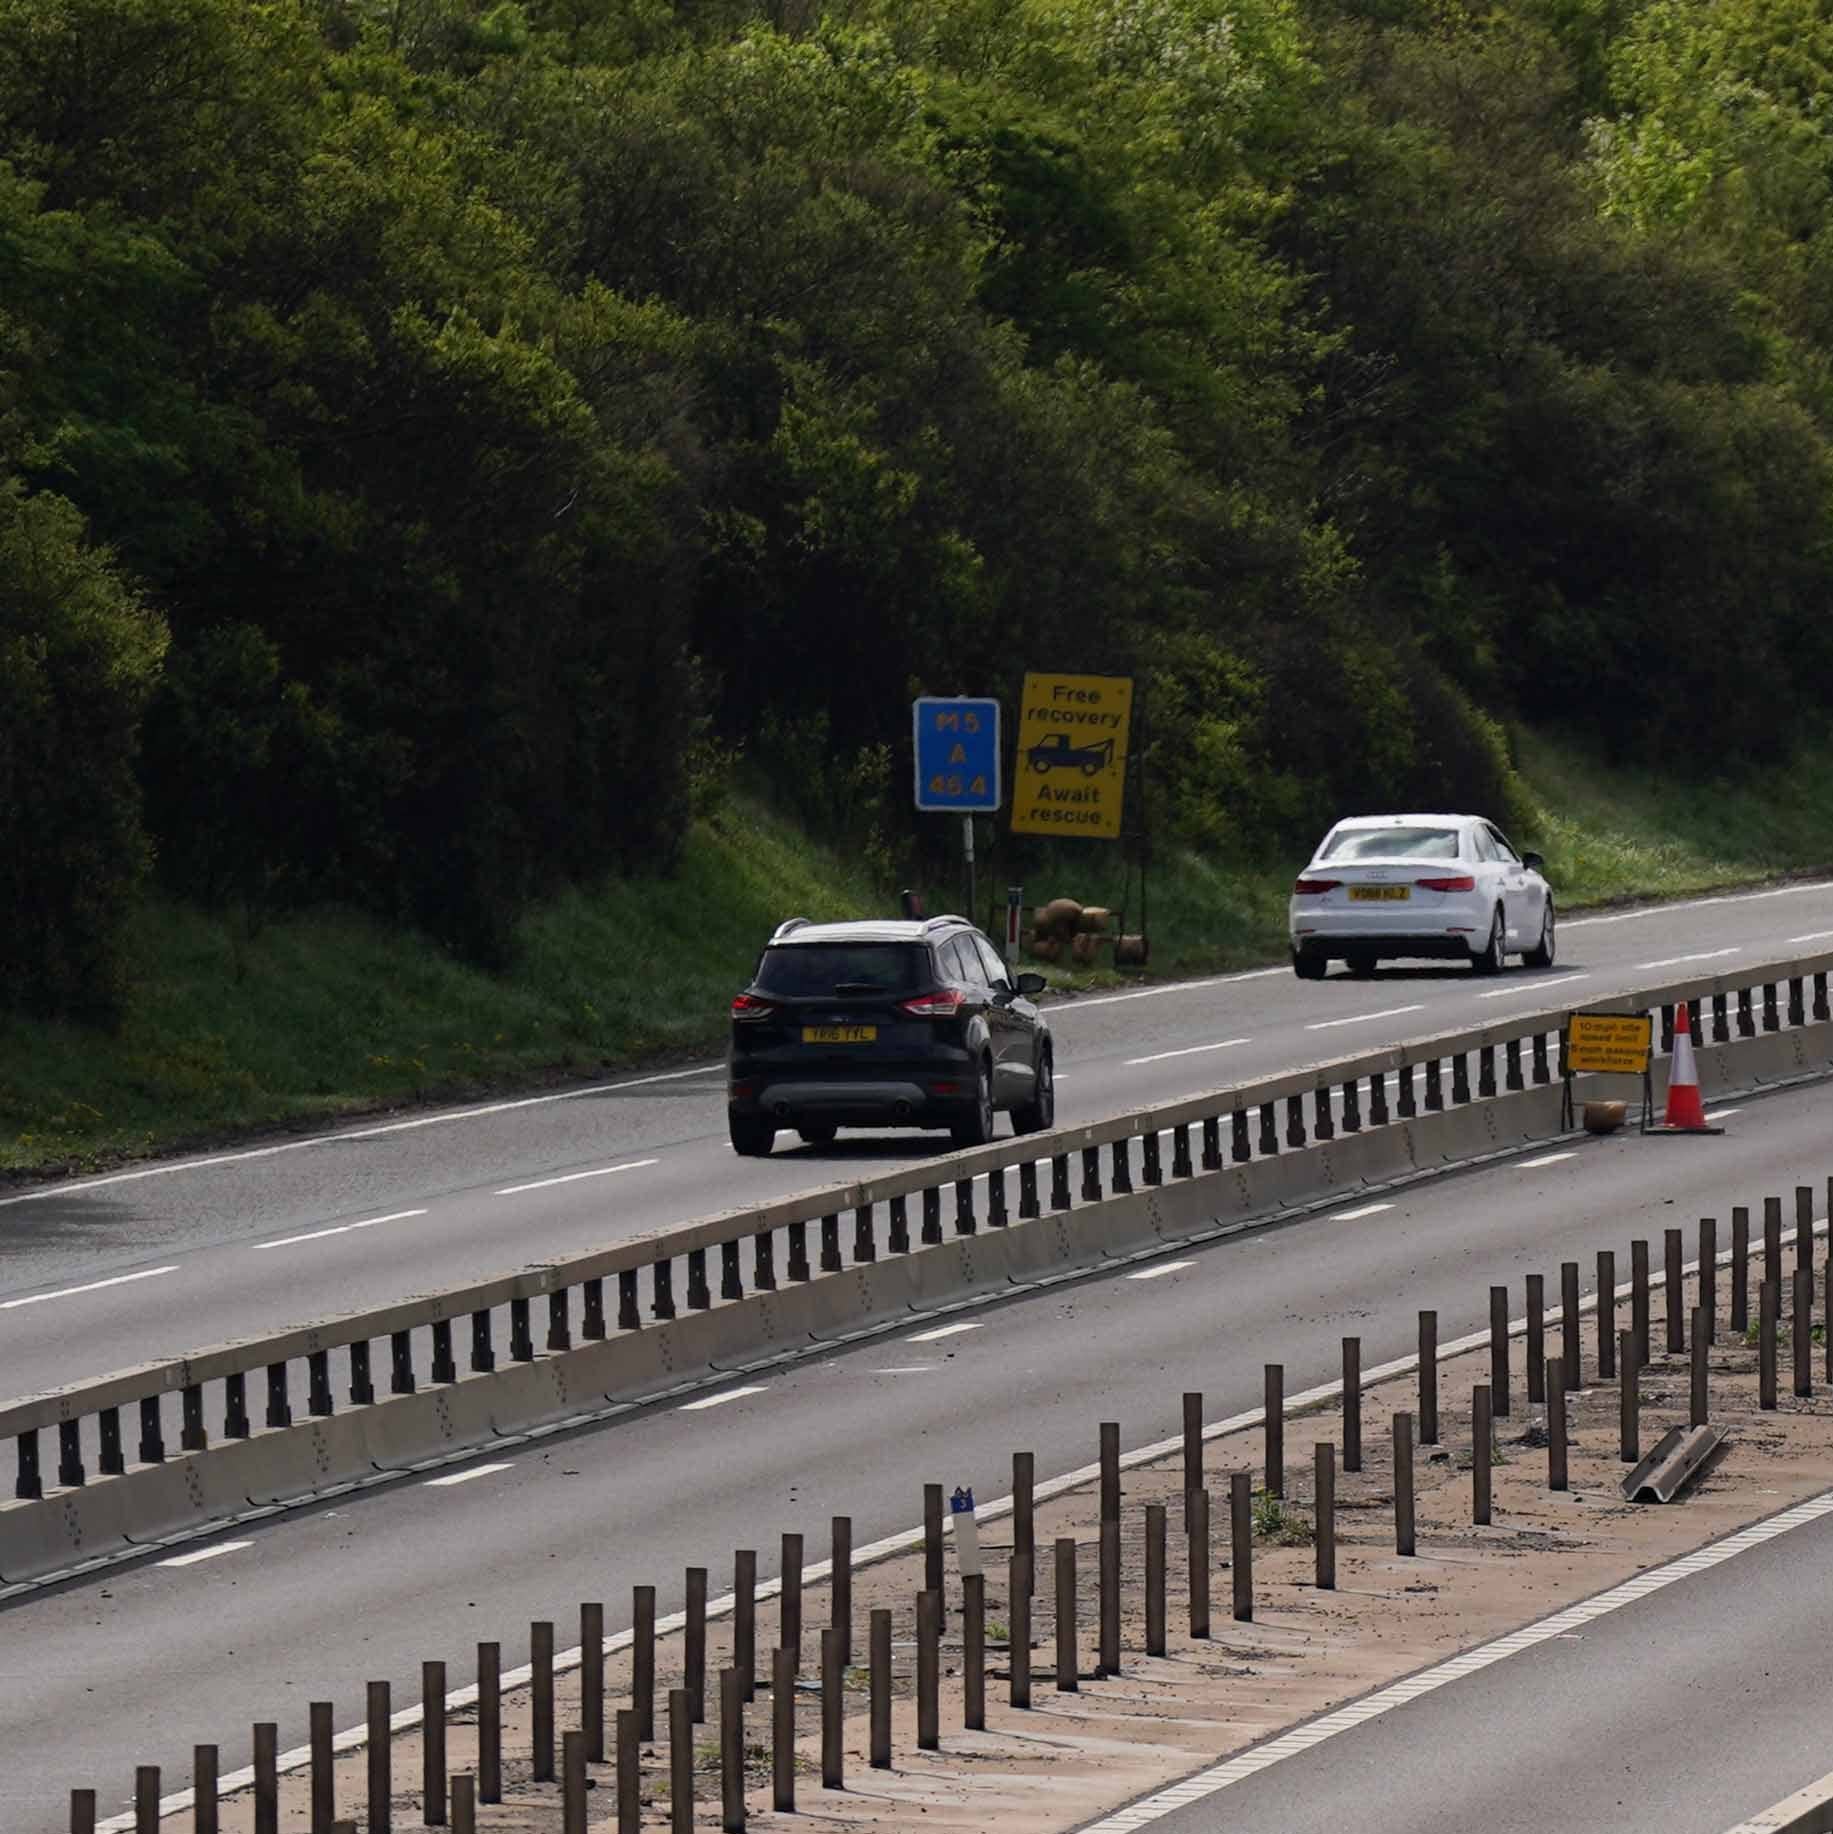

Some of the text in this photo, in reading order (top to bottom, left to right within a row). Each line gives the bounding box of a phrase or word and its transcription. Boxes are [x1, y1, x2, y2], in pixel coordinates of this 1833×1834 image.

[1051, 685, 1102, 705] Free
[1026, 707, 1122, 729] recovery
[1036, 783, 1102, 805] Await
[1029, 804, 1103, 825] rescue
